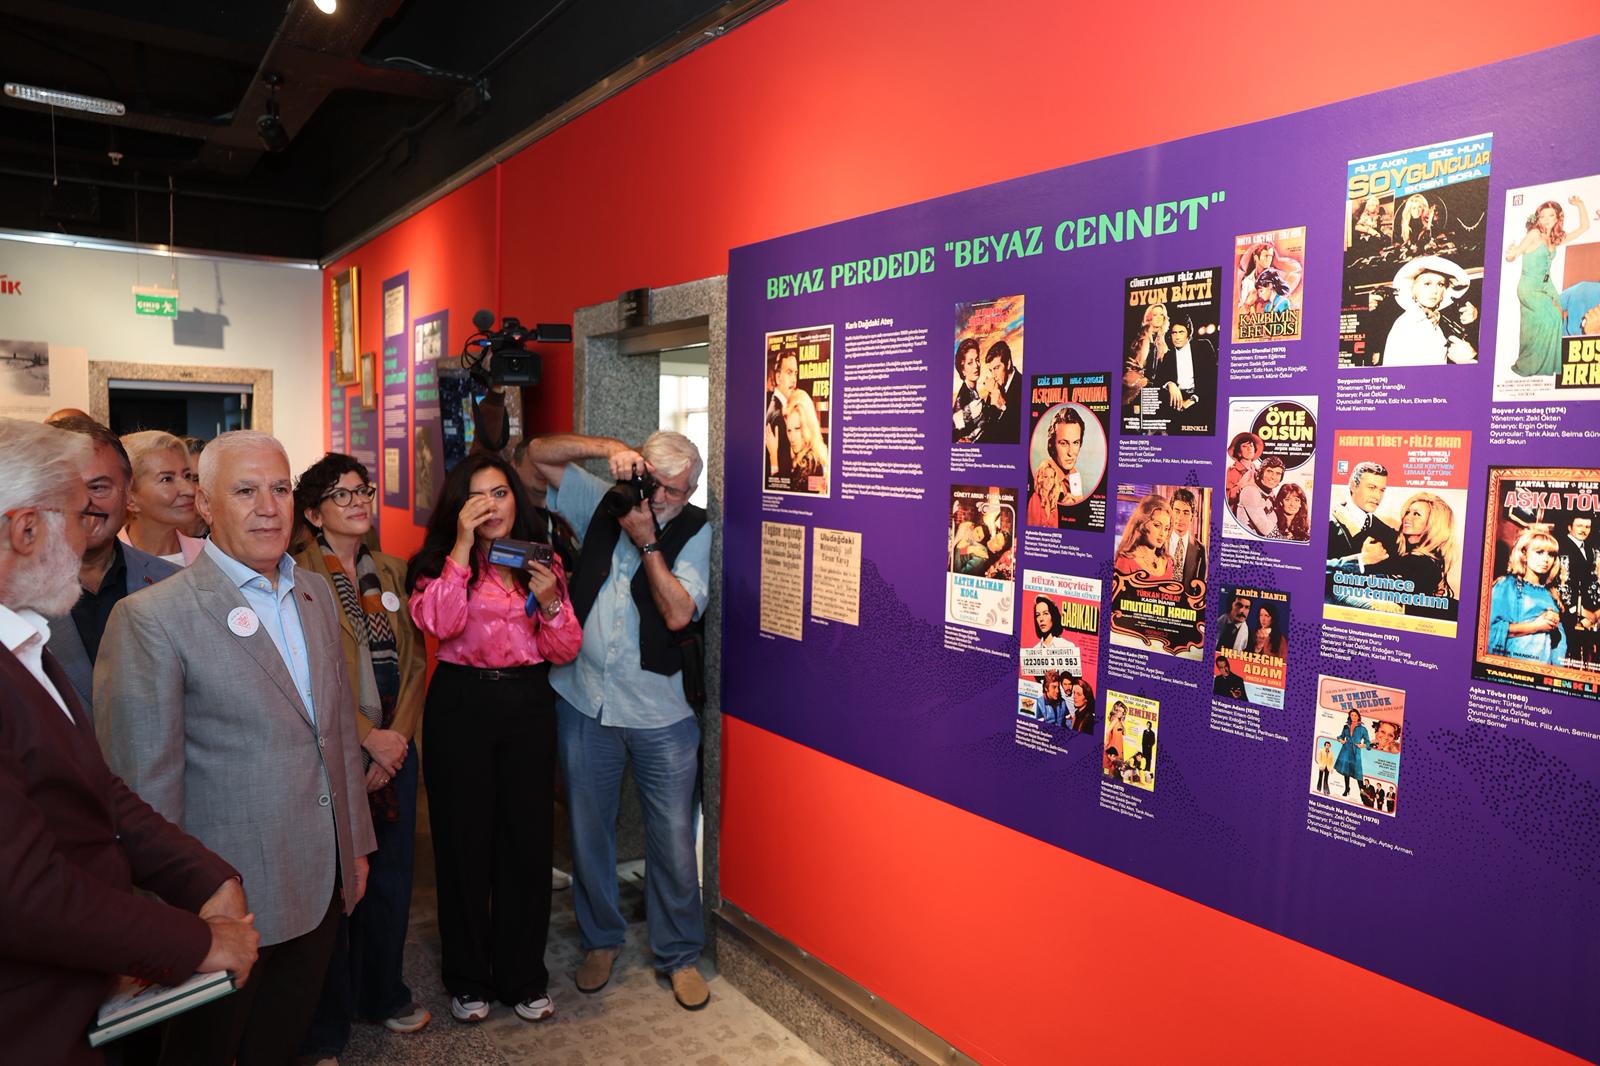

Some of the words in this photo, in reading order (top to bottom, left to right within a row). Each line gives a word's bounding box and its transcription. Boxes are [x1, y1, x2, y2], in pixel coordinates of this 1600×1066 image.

[1348, 151, 1491, 200] SOYGUNCULAR
[766, 267, 824, 300] BEYAZ
[830, 247, 935, 290] PERDEDE
[945, 225, 1043, 268] "BEYAZ
[1055, 190, 1226, 252] CENNET"
[1130, 278, 1153, 288] CÜNEYT
[1154, 275, 1175, 285] ARKIN
[1178, 271, 1193, 282] FİLİZ
[1194, 270, 1213, 279] AKIN
[1130, 288, 1168, 306] OYUN
[1171, 279, 1212, 302] BİTTİ
[1240, 309, 1299, 326] KALBİMİN
[1266, 407, 1306, 425] ÖYLE
[1516, 407, 1544, 415] Arkadaş
[1545, 406, 1566, 414] (1974)
[1258, 426, 1313, 441] OLSUN
[1339, 435, 1374, 446] KARTAL
[1376, 434, 1402, 447] TİBET
[1409, 435, 1433, 448] FİLİZ
[1434, 437, 1461, 448] AKIN
[1031, 575, 1054, 586] HÜLYA
[1333, 570, 1415, 592] ömrümce
[1236, 589, 1258, 598] KADİR
[1333, 584, 1449, 609] unutamadım
[1061, 600, 1098, 633] SABIKALI
[1120, 599, 1166, 616] UNUTULAN
[1168, 606, 1197, 621] KADIN
[1050, 658, 1055, 666] 3
[1243, 664, 1283, 680] ADAM
[1486, 669, 1535, 682] TAMAMEN
[1332, 694, 1344, 703] NE
[1346, 690, 1378, 701] UMDUK
[1470, 686, 1486, 695] Aşka
[1486, 690, 1506, 698] Tövbe
[1356, 697, 1391, 709] BULDUK
[1468, 701, 1493, 710] Senaryo:
[1510, 708, 1530, 718] Özlüer
[1469, 694, 1501, 704] Yönetmen:
[1502, 699, 1522, 709] Türker
[1523, 702, 1552, 715] İnanoğlu
[1466, 715, 1486, 724] Önder
[1486, 720, 1507, 728] Somer
[1468, 708, 1500, 720] Oyuncular:
[1501, 714, 1519, 723] Kartal
[1520, 718, 1538, 728] Tibet,
[1539, 722, 1552, 730] Filiz
[1554, 726, 1570, 734] Akın,
